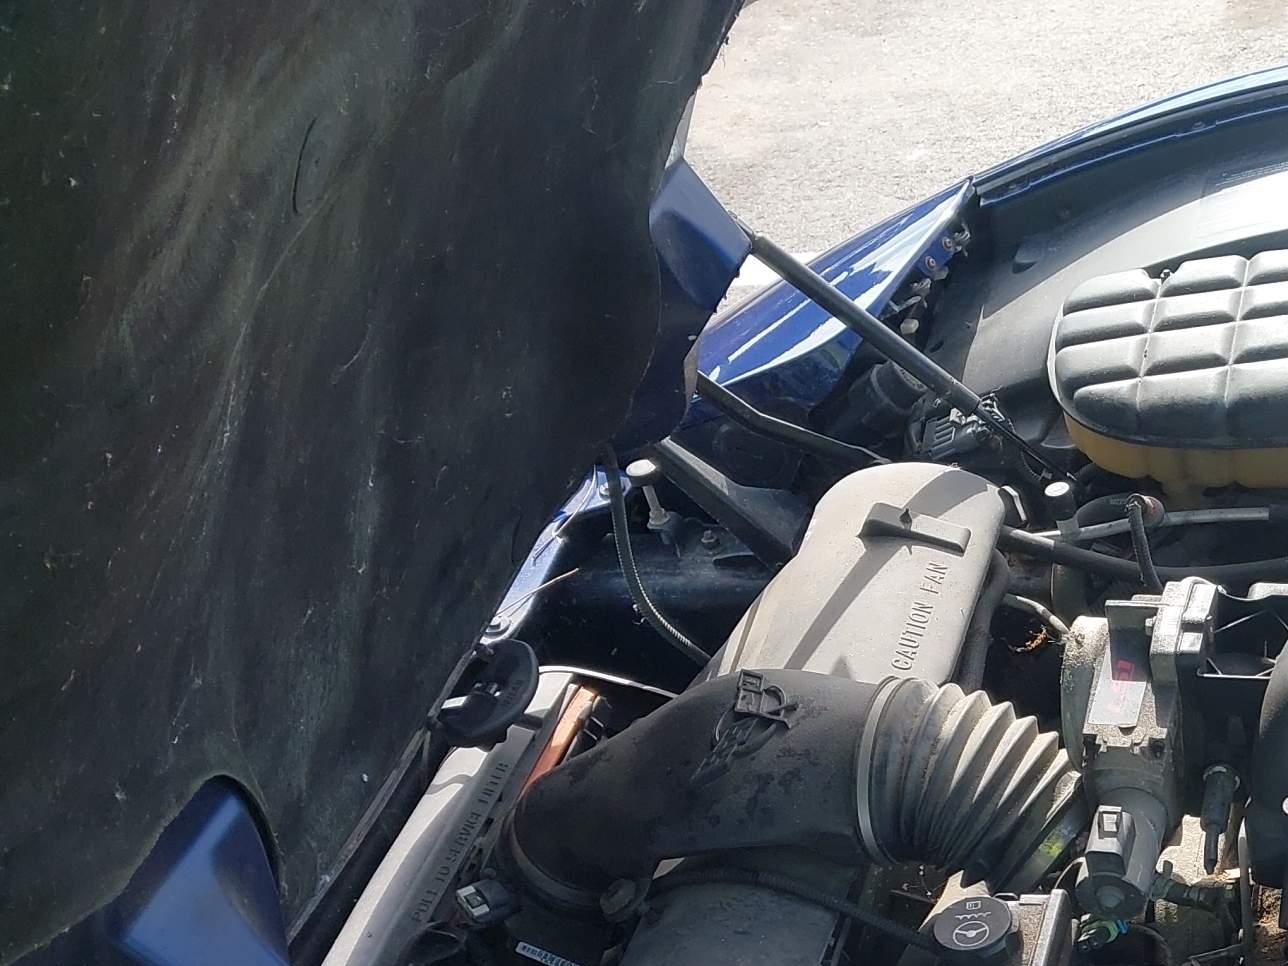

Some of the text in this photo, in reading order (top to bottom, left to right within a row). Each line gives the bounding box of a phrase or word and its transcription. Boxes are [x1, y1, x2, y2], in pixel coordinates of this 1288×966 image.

[891, 562, 948, 671] CAUTION FAN
[411, 762, 508, 922] PULL TO SERVICE FILTER
